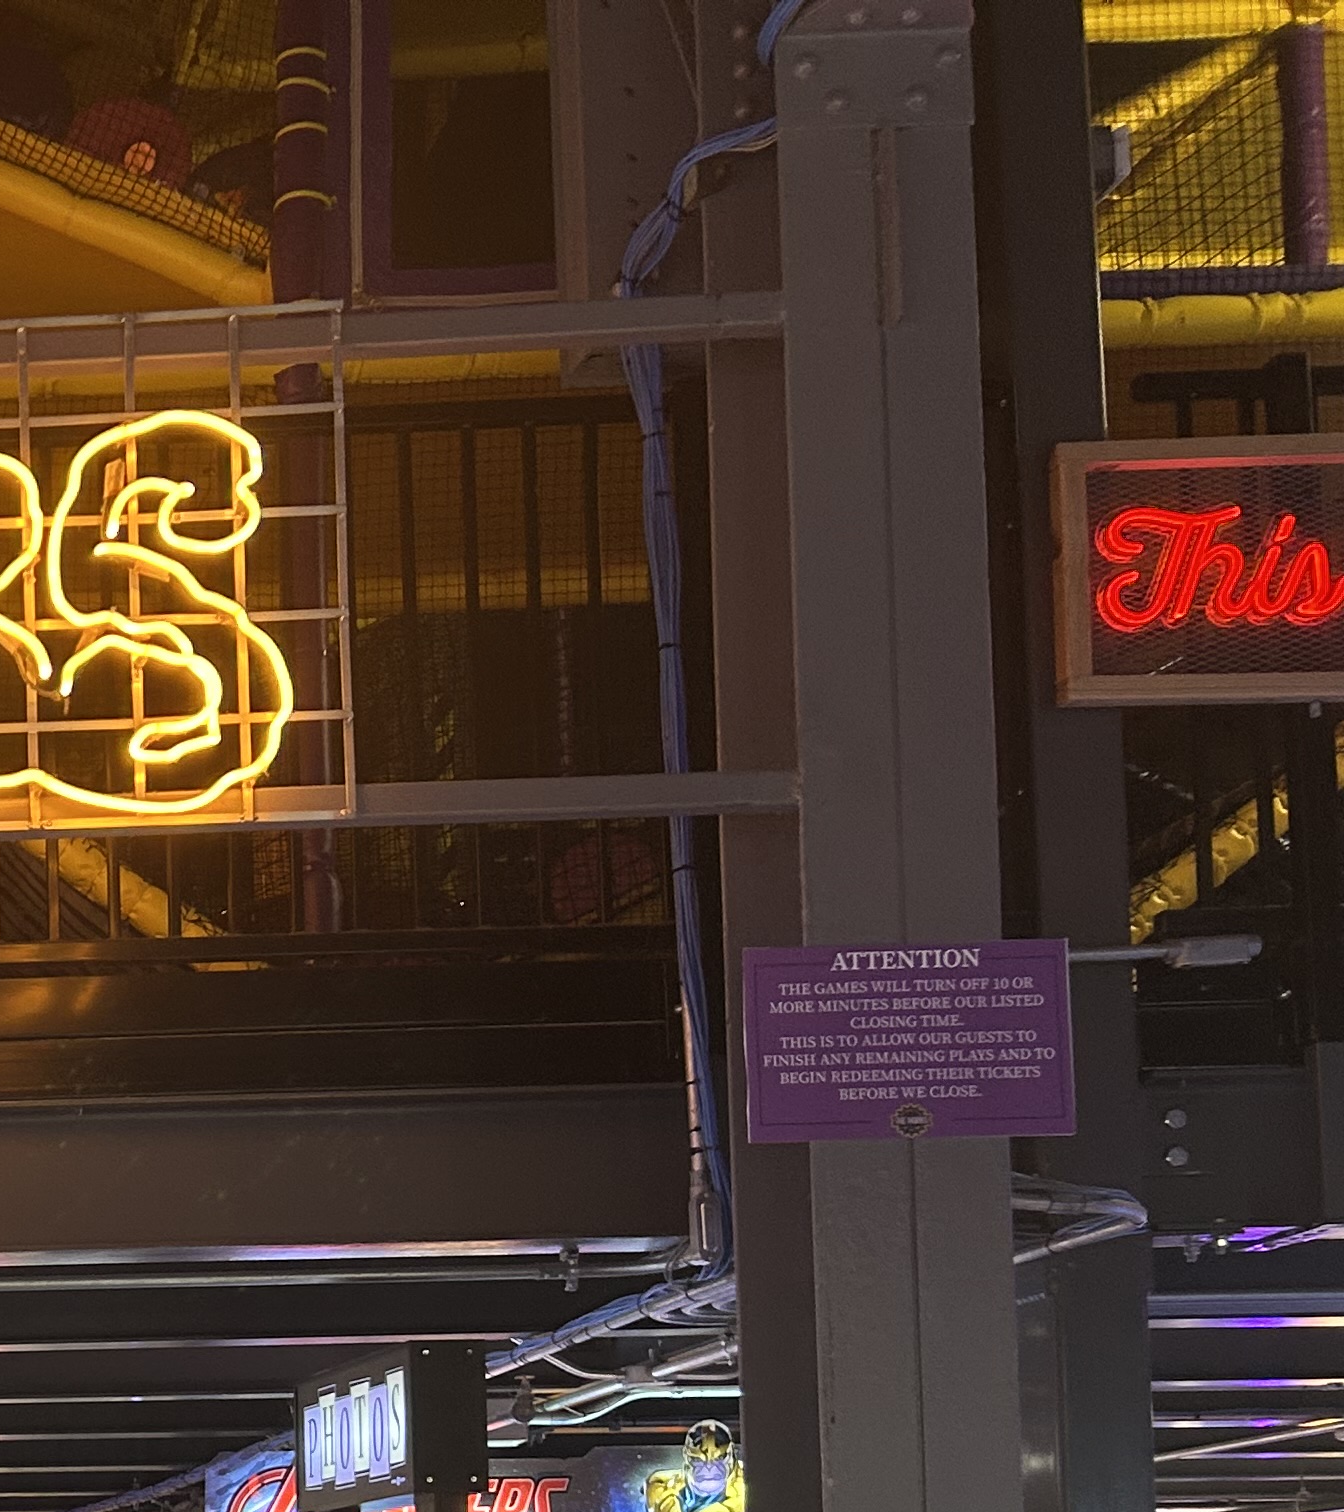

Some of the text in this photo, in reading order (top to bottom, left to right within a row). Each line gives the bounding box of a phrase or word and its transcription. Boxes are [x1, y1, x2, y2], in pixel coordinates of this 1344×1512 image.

[1095, 503, 1344, 634] This
[830, 948, 980, 972] ATTENTION
[778, 976, 1034, 997] THE GAMES WILL TURN OFF 10 OR
[769, 994, 1044, 1014] MORE MINUTES BEFORE OUR LISTED
[850, 1015, 917, 1030] CLOSING
[780, 1030, 1037, 1050] THIS IS TO ALLOW OUR GUESTS TO
[763, 1047, 1056, 1067] FINISH ANY REMAINING PLAYS AND TO
[780, 1066, 1041, 1085] BEGIN REDEEMING THEIR TICKETS
[839, 1087, 898, 1100] BEFORE
[902, 1086, 926, 1098] WE
[307, 1382, 404, 1479] PHOTOS
